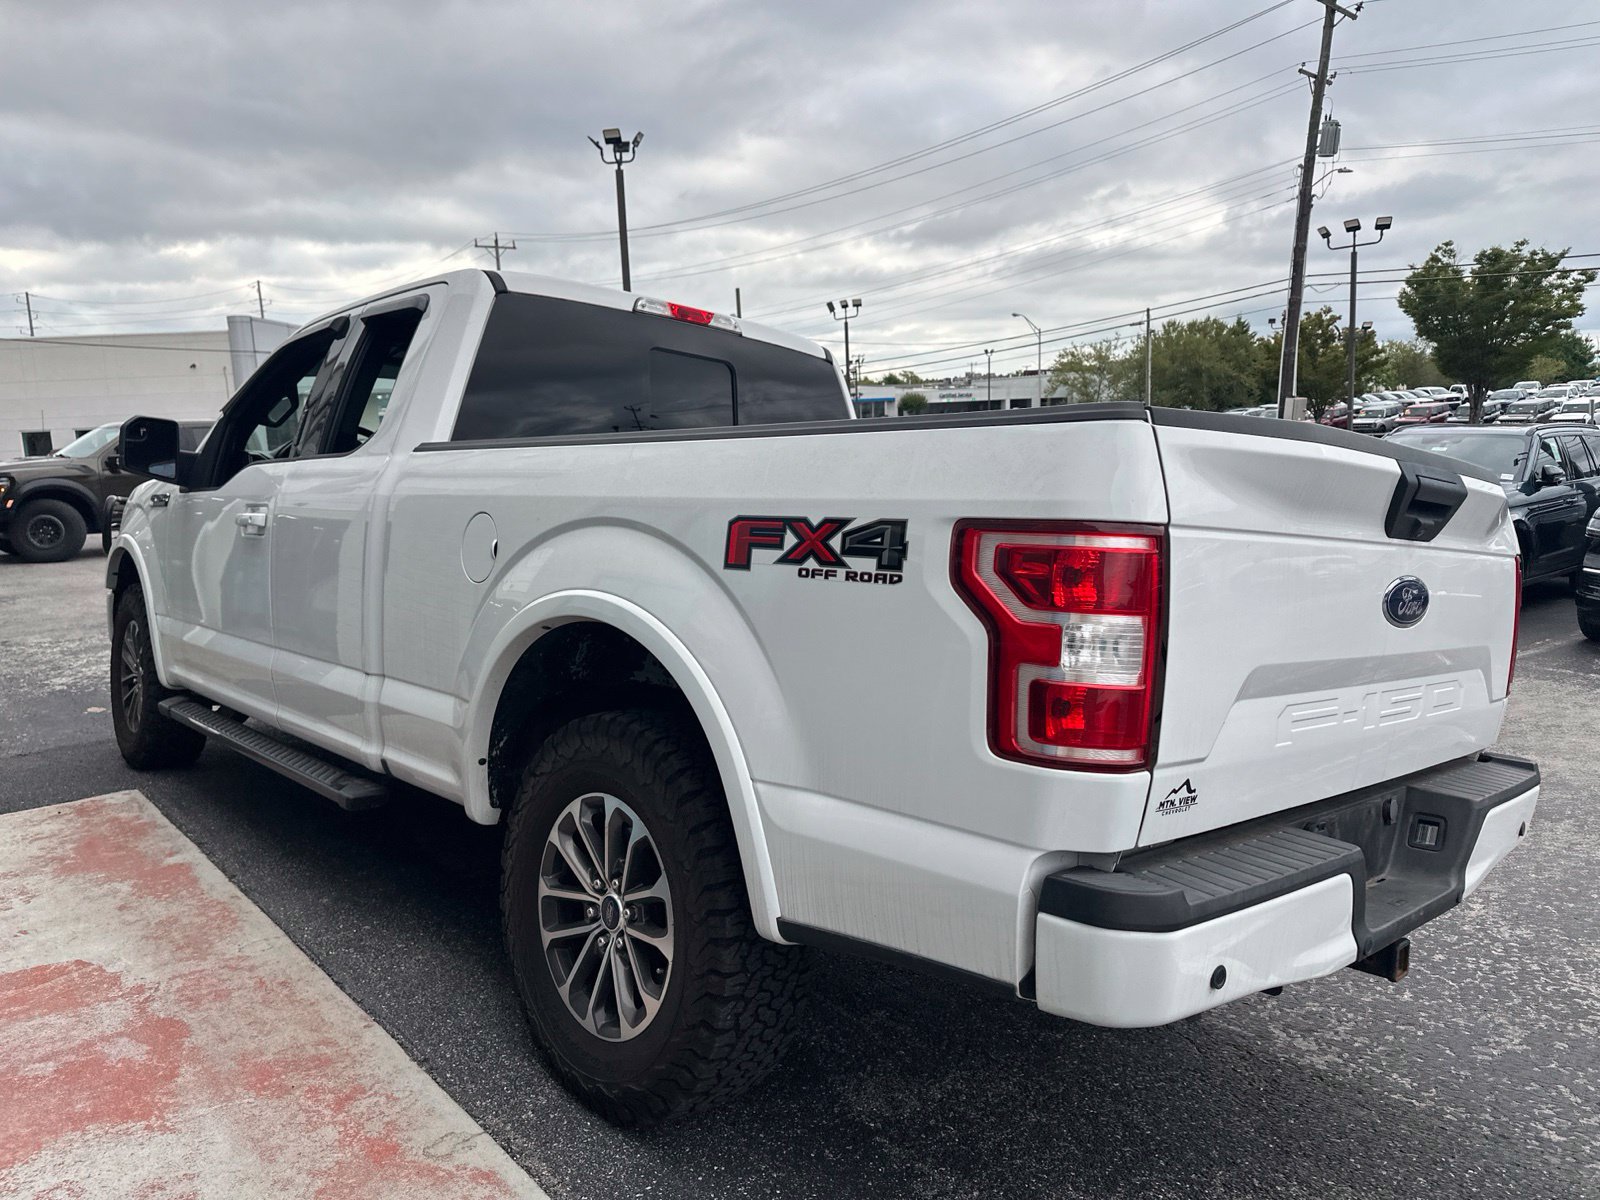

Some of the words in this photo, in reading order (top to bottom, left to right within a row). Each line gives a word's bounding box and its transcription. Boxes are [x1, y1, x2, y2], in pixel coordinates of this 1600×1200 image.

[723, 514, 909, 573] FX4
[798, 567, 837, 580] OFF
[845, 570, 903, 585] ROAD
[1398, 587, 1424, 615] Ford
[1275, 679, 1464, 747] F-150
[1158, 799, 1177, 810] MTN.
[1179, 795, 1198, 806] VIEW
[1162, 806, 1191, 816] CHEVROLET
